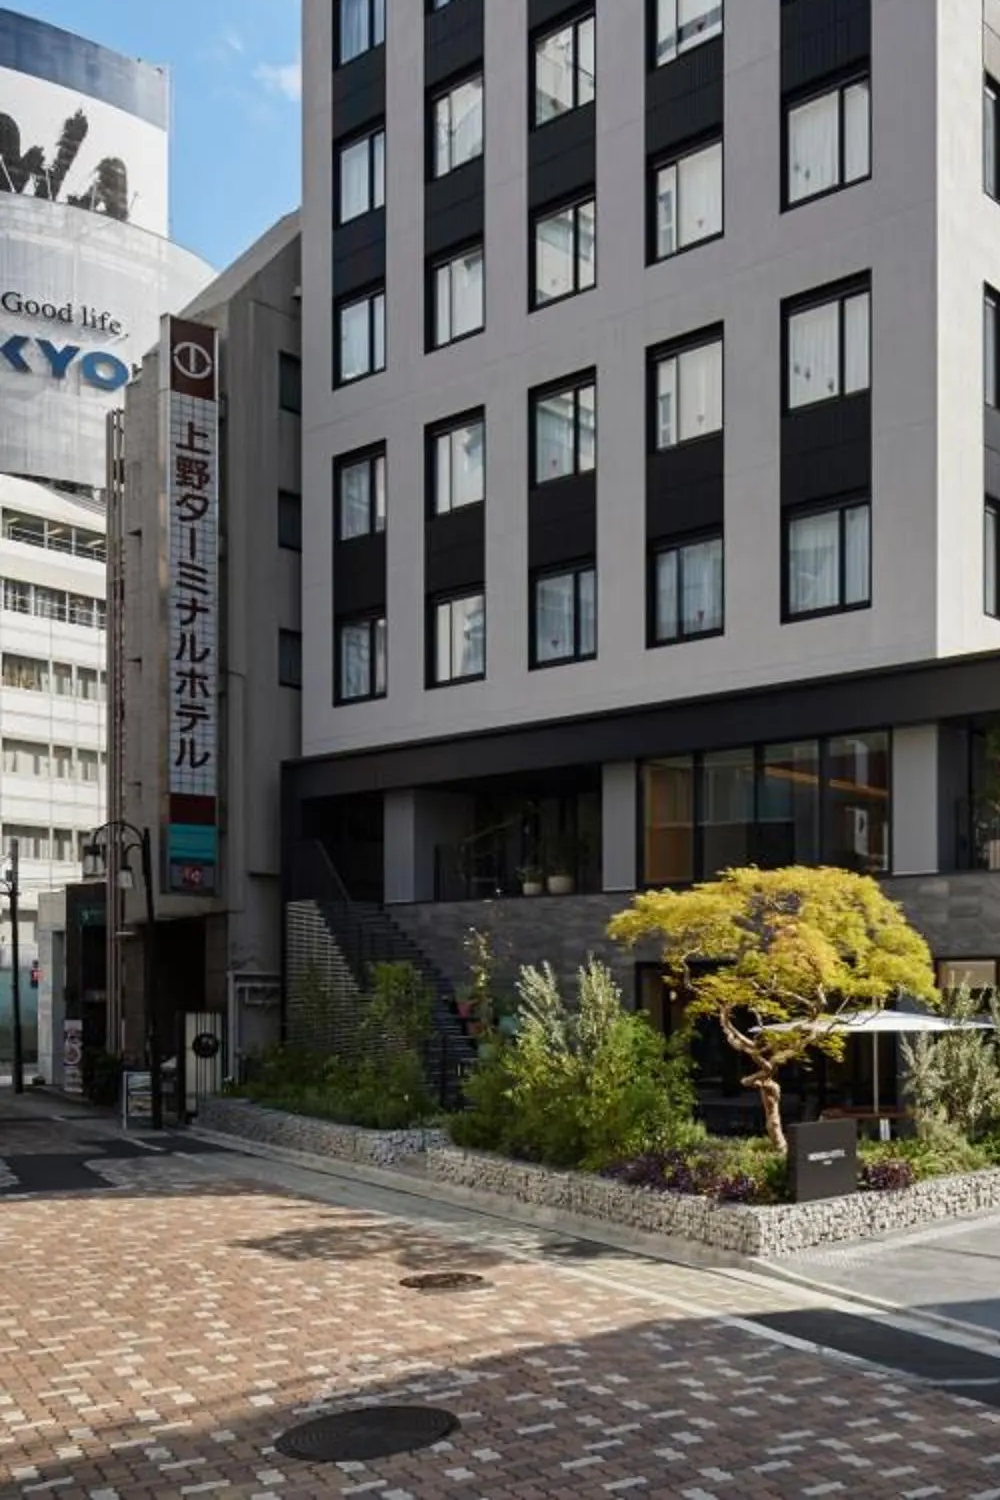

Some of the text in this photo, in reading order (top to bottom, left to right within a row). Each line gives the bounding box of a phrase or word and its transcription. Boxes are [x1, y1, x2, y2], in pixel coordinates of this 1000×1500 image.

[1, 291, 73, 322] Good
[175, 421, 211, 769] 上野ターミナルホテル
